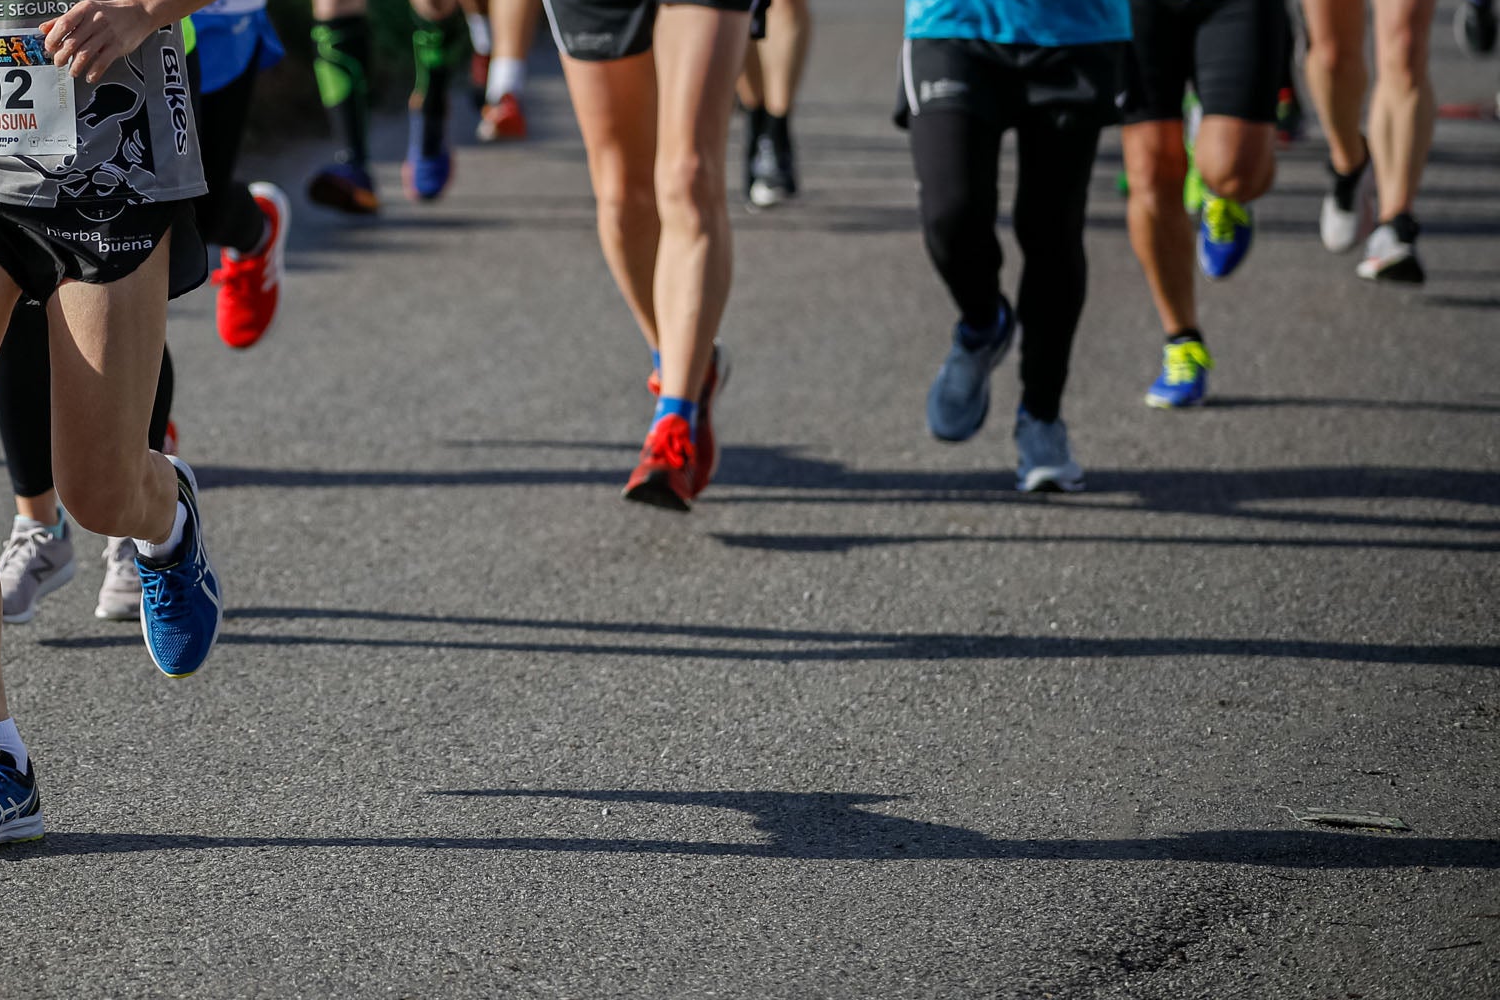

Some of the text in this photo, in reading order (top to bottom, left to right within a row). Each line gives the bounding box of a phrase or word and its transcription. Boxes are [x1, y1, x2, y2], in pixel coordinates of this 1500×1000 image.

[160, 46, 188, 156] Bikes
[46, 226, 101, 242] hierba
[98, 239, 153, 253] buena
